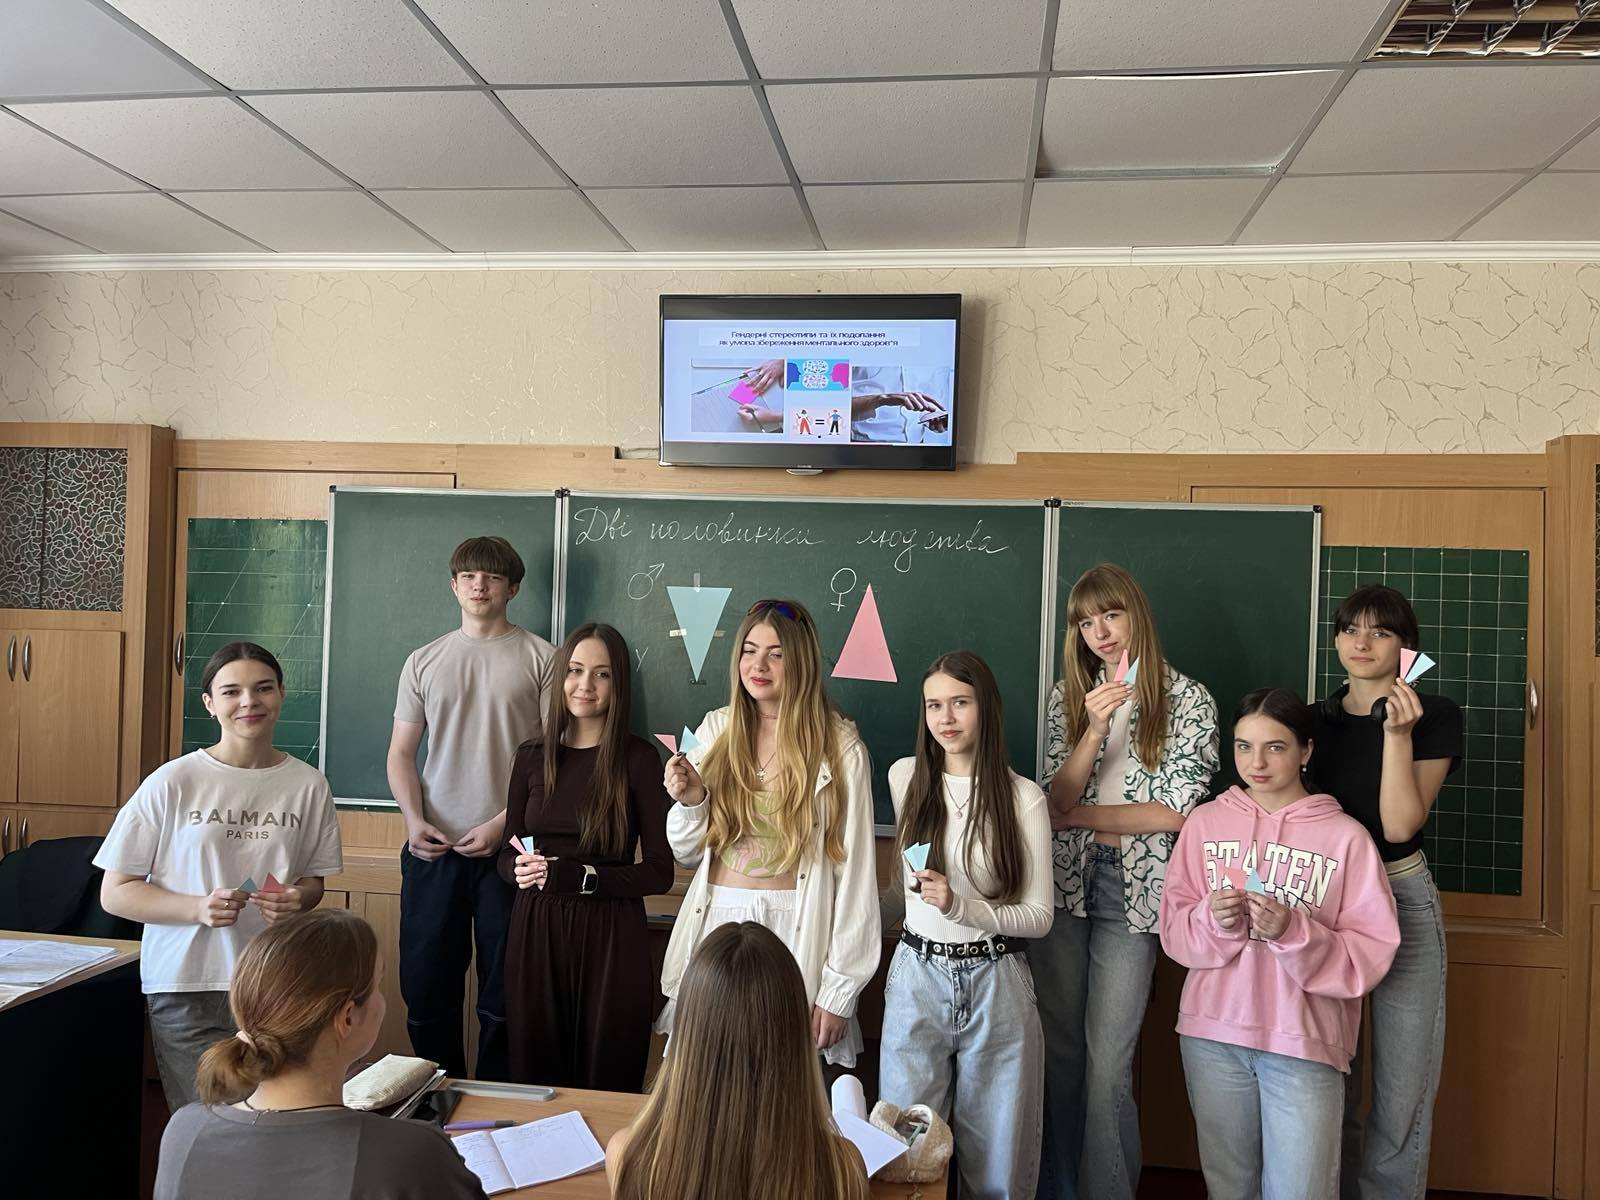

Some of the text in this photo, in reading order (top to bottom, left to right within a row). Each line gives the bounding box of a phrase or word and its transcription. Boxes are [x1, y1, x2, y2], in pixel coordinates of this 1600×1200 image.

[731, 331, 767, 339] Гендерні
[573, 505, 632, 545] Дві
[650, 511, 824, 544] половинки
[189, 808, 303, 830] BALMAIN
[226, 829, 270, 840] PARIS
[1203, 839, 1339, 909] STATEN
